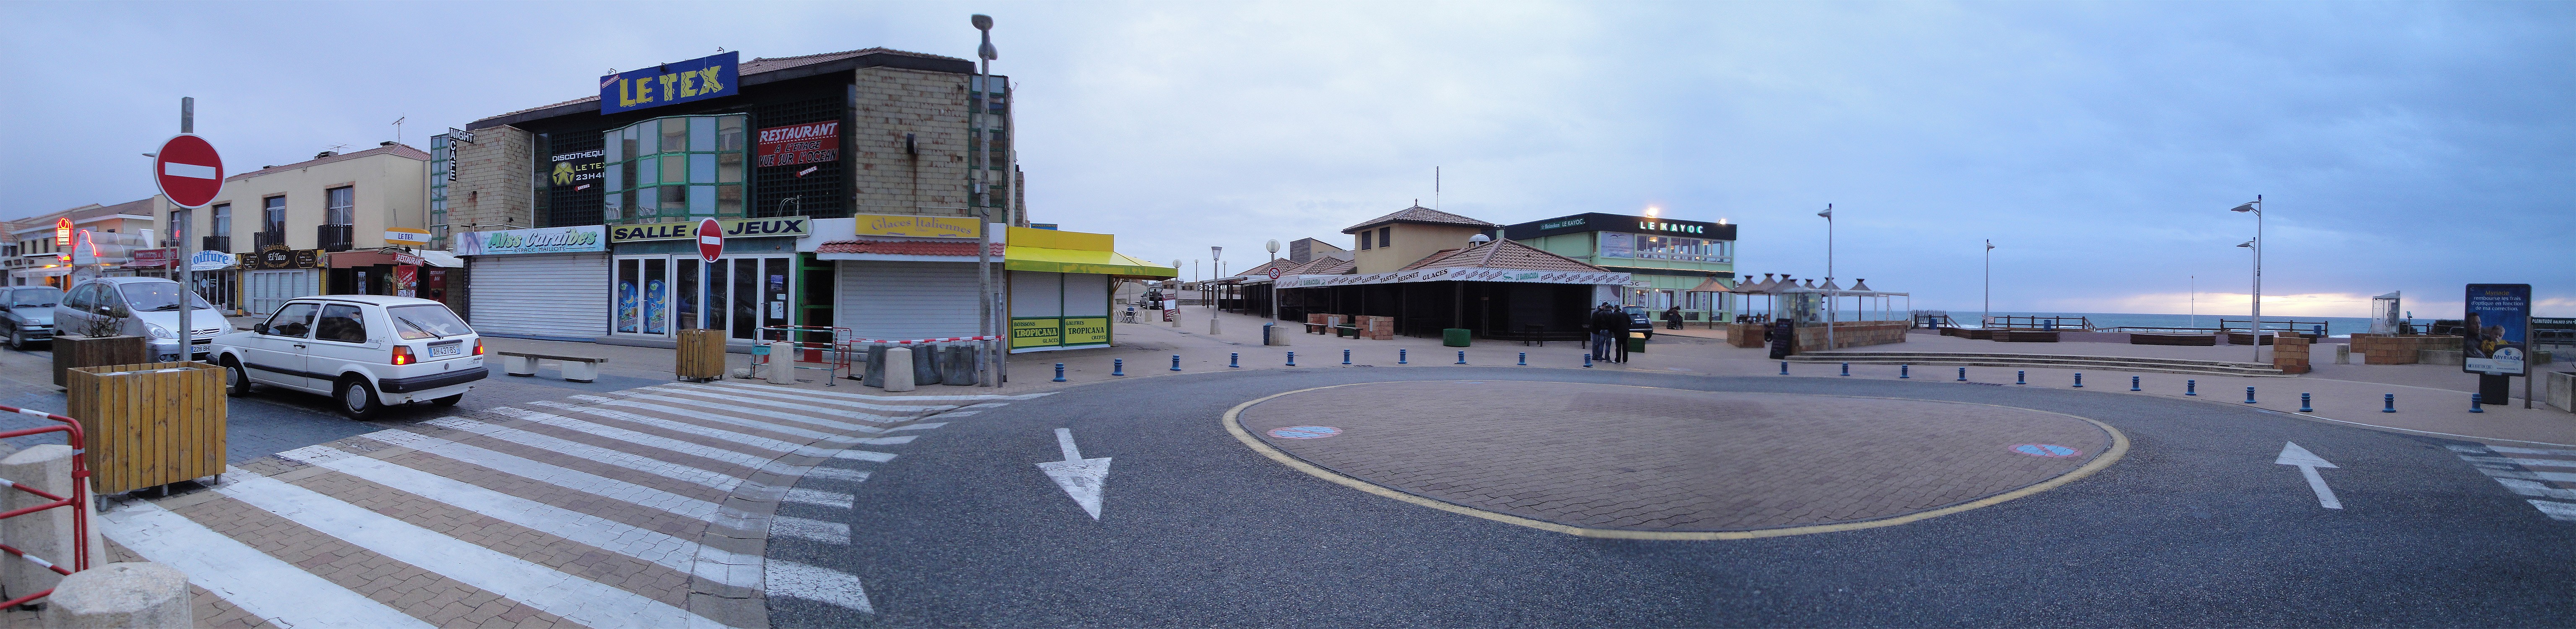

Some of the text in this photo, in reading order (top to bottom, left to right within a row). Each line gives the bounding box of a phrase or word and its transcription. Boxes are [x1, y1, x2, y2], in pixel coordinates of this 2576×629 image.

[601, 74, 619, 88] RESTAURANT
[619, 65, 724, 107] LE TEX
[450, 128, 473, 143] NIGHT
[759, 122, 838, 143] RESTAURANT
[774, 140, 822, 153] A L'ETAGE
[552, 150, 604, 161] DISCOTHEQU
[759, 148, 838, 167] VUE SUR L'OCEAN
[799, 166, 817, 176] ENTREE
[614, 225, 687, 240] SALLE
[728, 219, 804, 235] JEUX
[872, 217, 971, 234] Glaces Italiennes
[1639, 221, 1704, 234] LE KAYOC
[488, 227, 597, 249] Miss Caraïbes
[263, 243, 290, 254] Sandwicherie
[193, 250, 228, 264] oiffure
[397, 253, 424, 265] RESTAURANT
[1339, 276, 1348, 285] PIZZA
[1348, 276, 1362, 284] CRÊPES
[1362, 274, 1380, 283] GAUFRES
[1380, 273, 1398, 283] TARTES
[1397, 272, 1419, 282] BEIGNET
[1423, 269, 1447, 281] GLACES
[1451, 269, 1502, 281] SANDWICHS SALADES FRITES GRILLADES
[1520, 272, 1538, 281] BARRACUDA
[1540, 273, 1553, 281] PIZZA
[1552, 273, 1567, 282] PANINIS
[1565, 273, 1580, 283] CRÊPES
[1579, 273, 1594, 283] GAUFRES
[1593, 274, 1608, 283] TARTES
[1605, 275, 1619, 283] BEIGNETS
[1618, 275, 1630, 284] GLACES
[1015, 328, 1057, 337] TROPICANA
[433, 347, 456, 356] AH-437-BS
